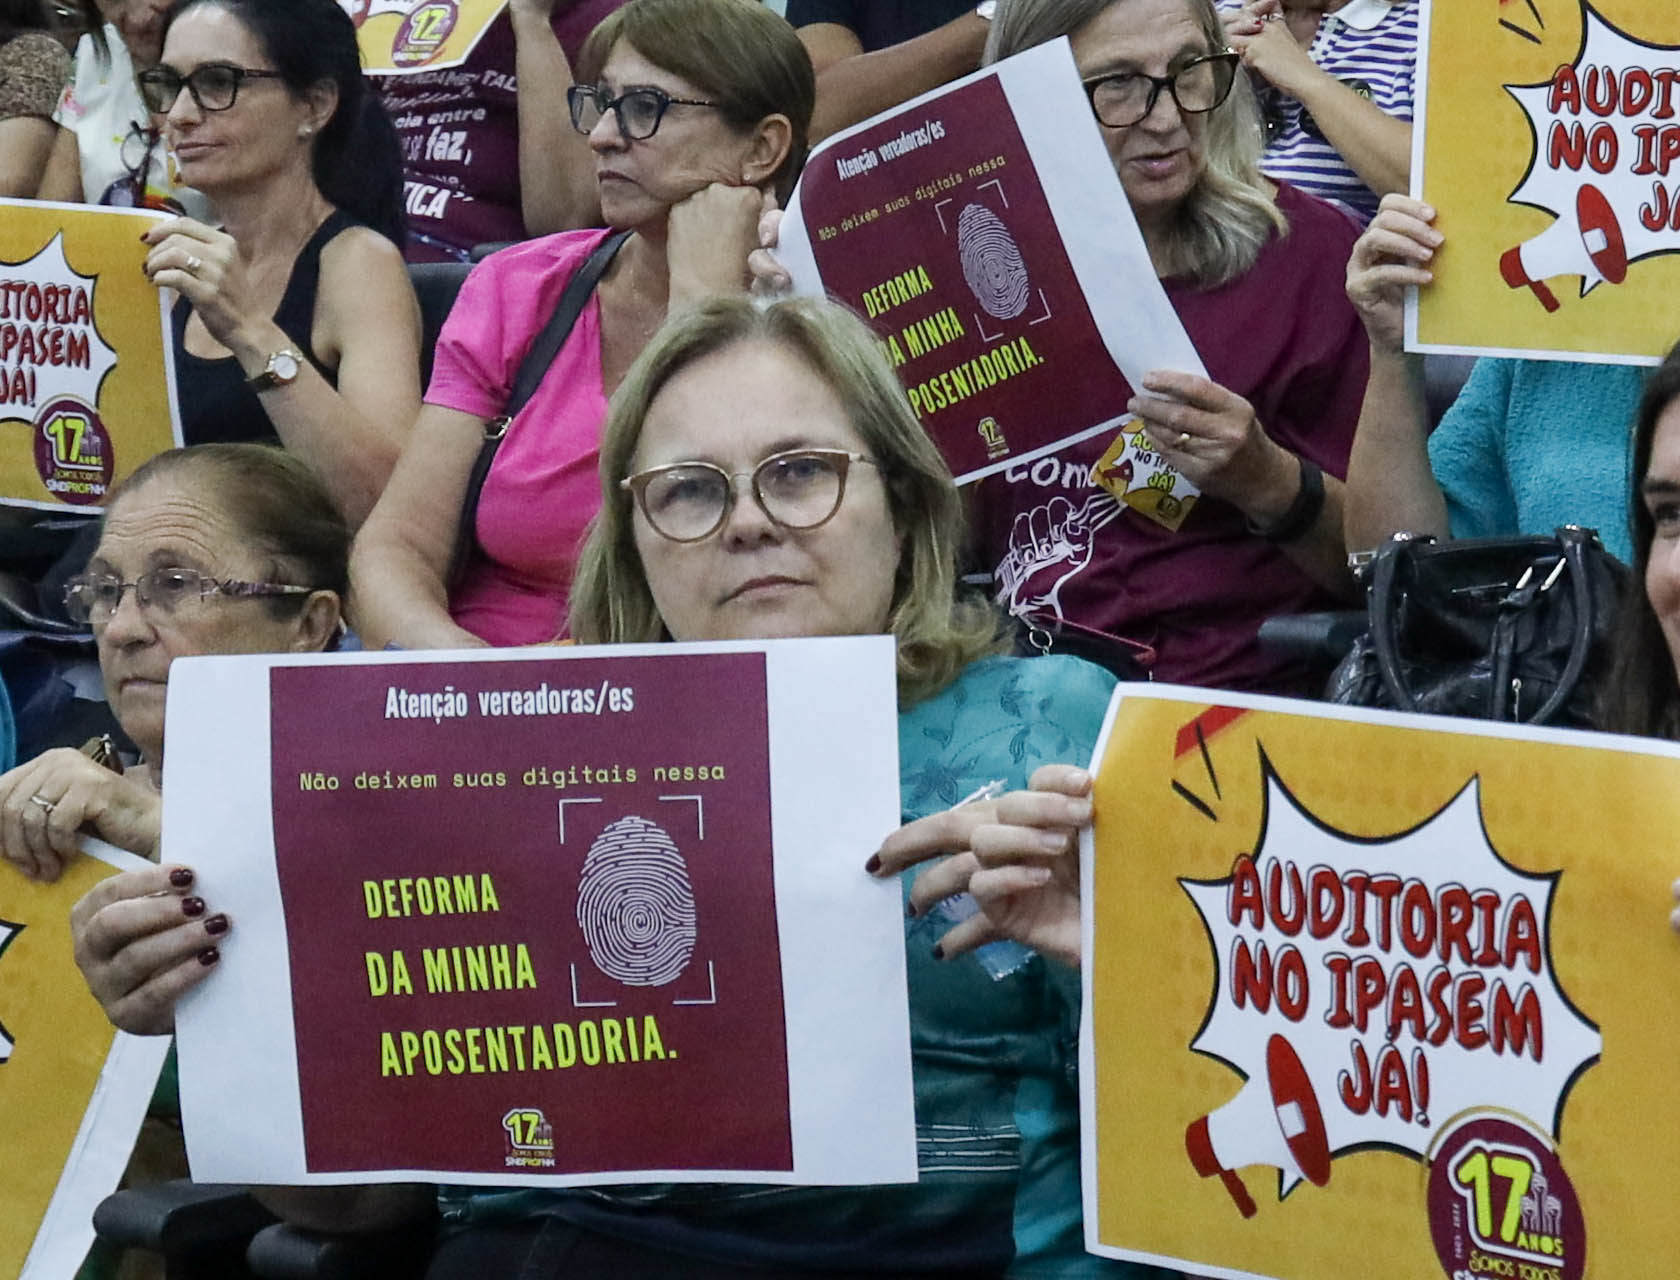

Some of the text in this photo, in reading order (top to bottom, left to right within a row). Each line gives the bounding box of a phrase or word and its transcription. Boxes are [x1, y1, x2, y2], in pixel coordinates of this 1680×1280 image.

[836, 120, 946, 182] Atenção vereadoras/es
[1548, 120, 1619, 174] NO
[819, 155, 1007, 241] Não deixem suas digitais nessa
[862, 265, 933, 320] DEFORMA
[908, 307, 966, 360] MINHA
[908, 337, 1045, 420] POSENTADORIA.
[48, 418, 85, 461] 17
[385, 680, 634, 726] Atenção vereadoras/es
[299, 763, 726, 792] Não deixem suas digitais nessa
[363, 873, 499, 920] DEFORMA
[1227, 853, 1543, 976] AUDITORIA
[366, 943, 537, 997] DA MINHA
[1231, 935, 1546, 1066] NO IPASEM
[381, 1015, 678, 1078] APOSENTADORIA.
[1337, 1028, 1431, 1128] JÁ!
[506, 1112, 539, 1144] 17
[1457, 1151, 1564, 1257] 17 ANOS
[1469, 1250, 1516, 1278] SOMOS
